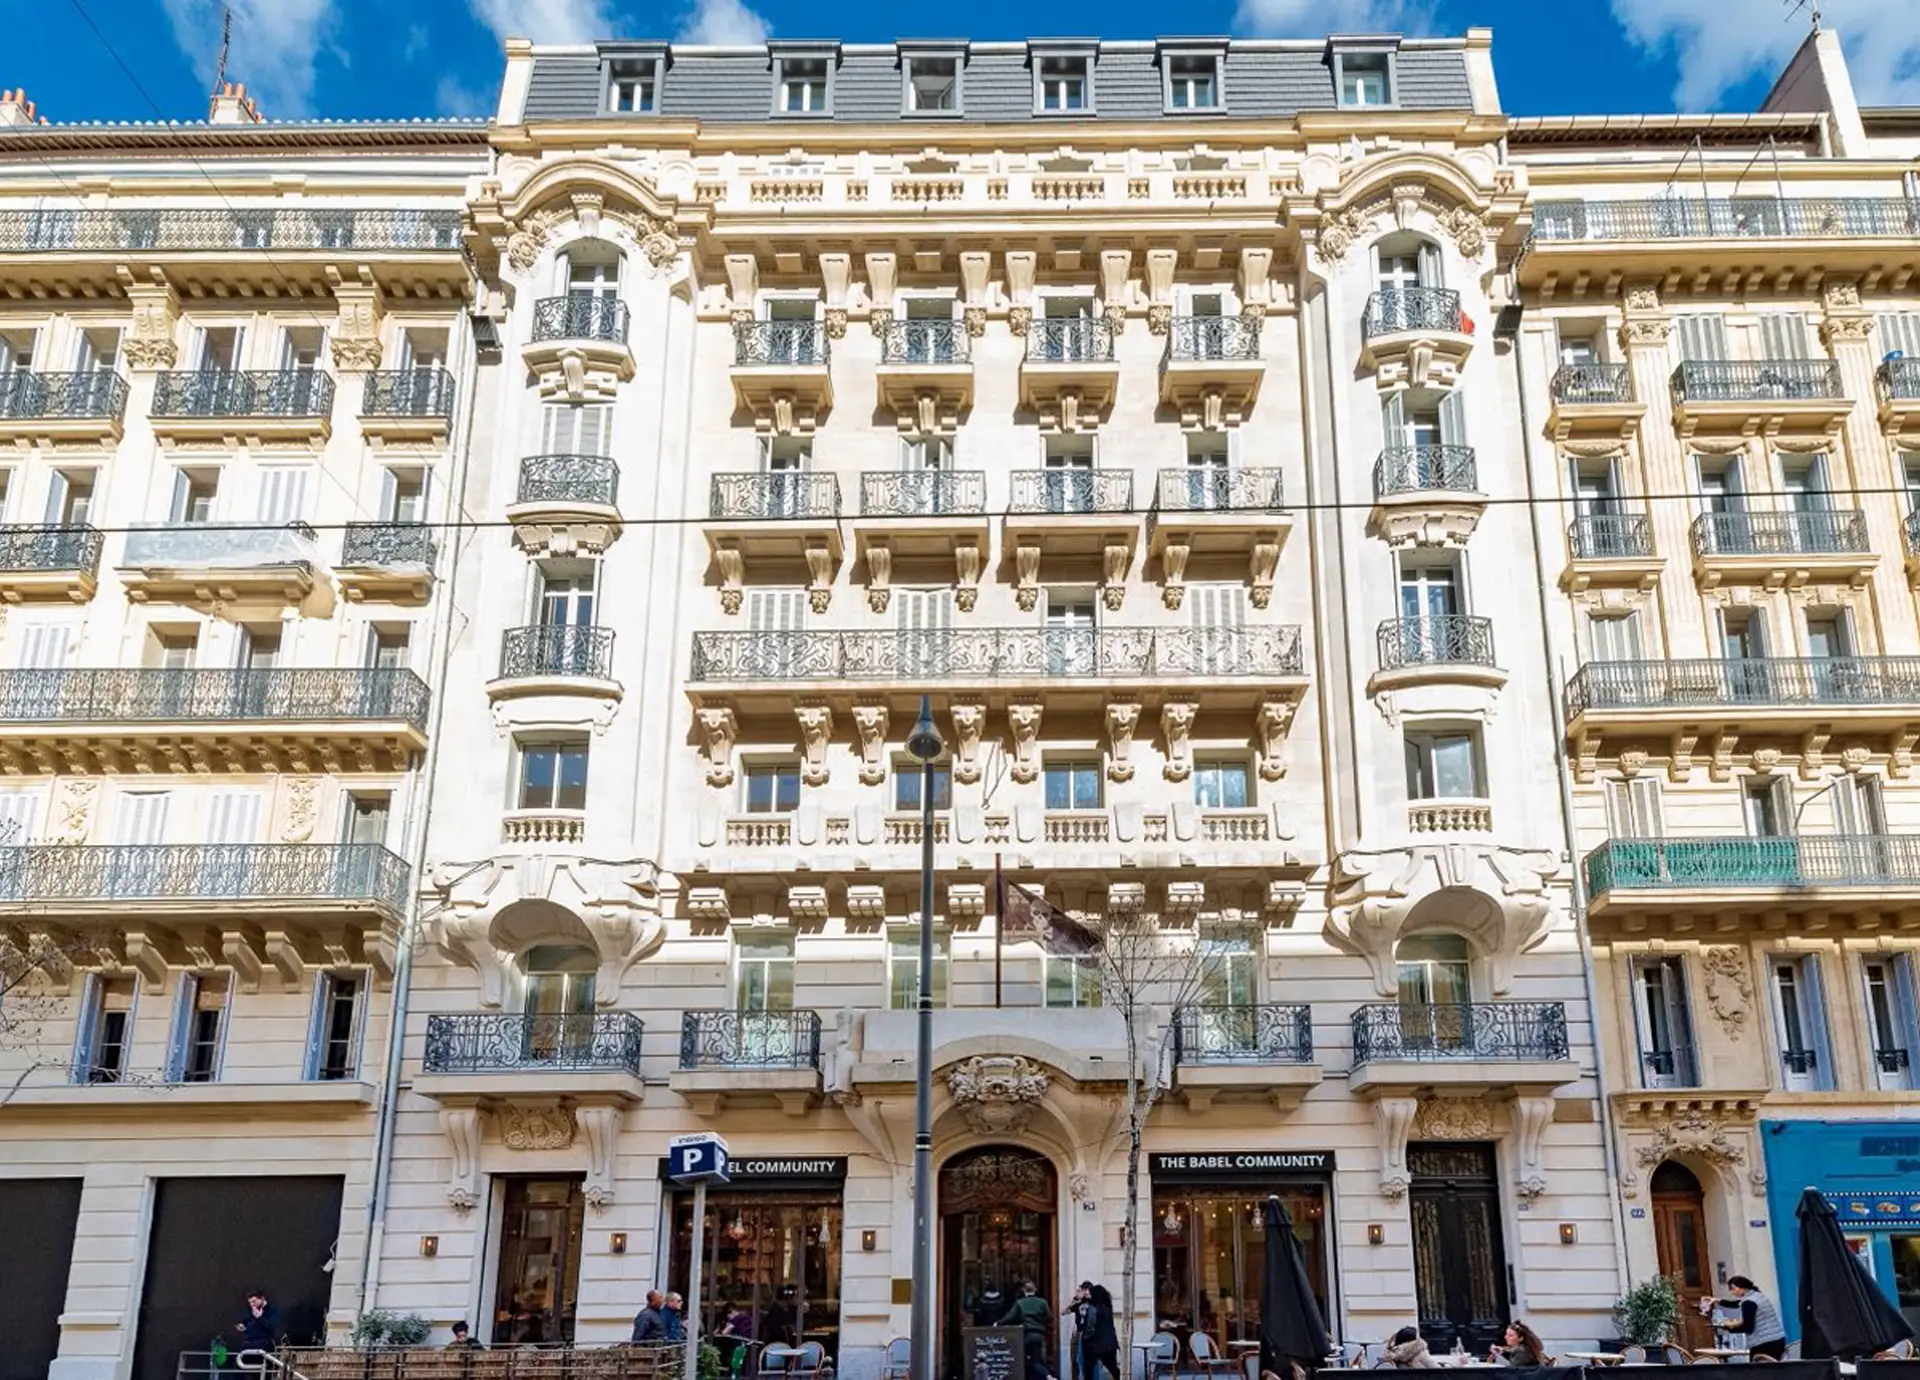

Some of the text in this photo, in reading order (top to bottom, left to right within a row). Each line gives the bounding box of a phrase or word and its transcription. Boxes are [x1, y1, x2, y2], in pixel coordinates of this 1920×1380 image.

[682, 1148, 703, 1172] P
[746, 1160, 836, 1173] COMMUNITY
[1159, 1155, 1325, 1168] THE BABEL COMMUNITY
